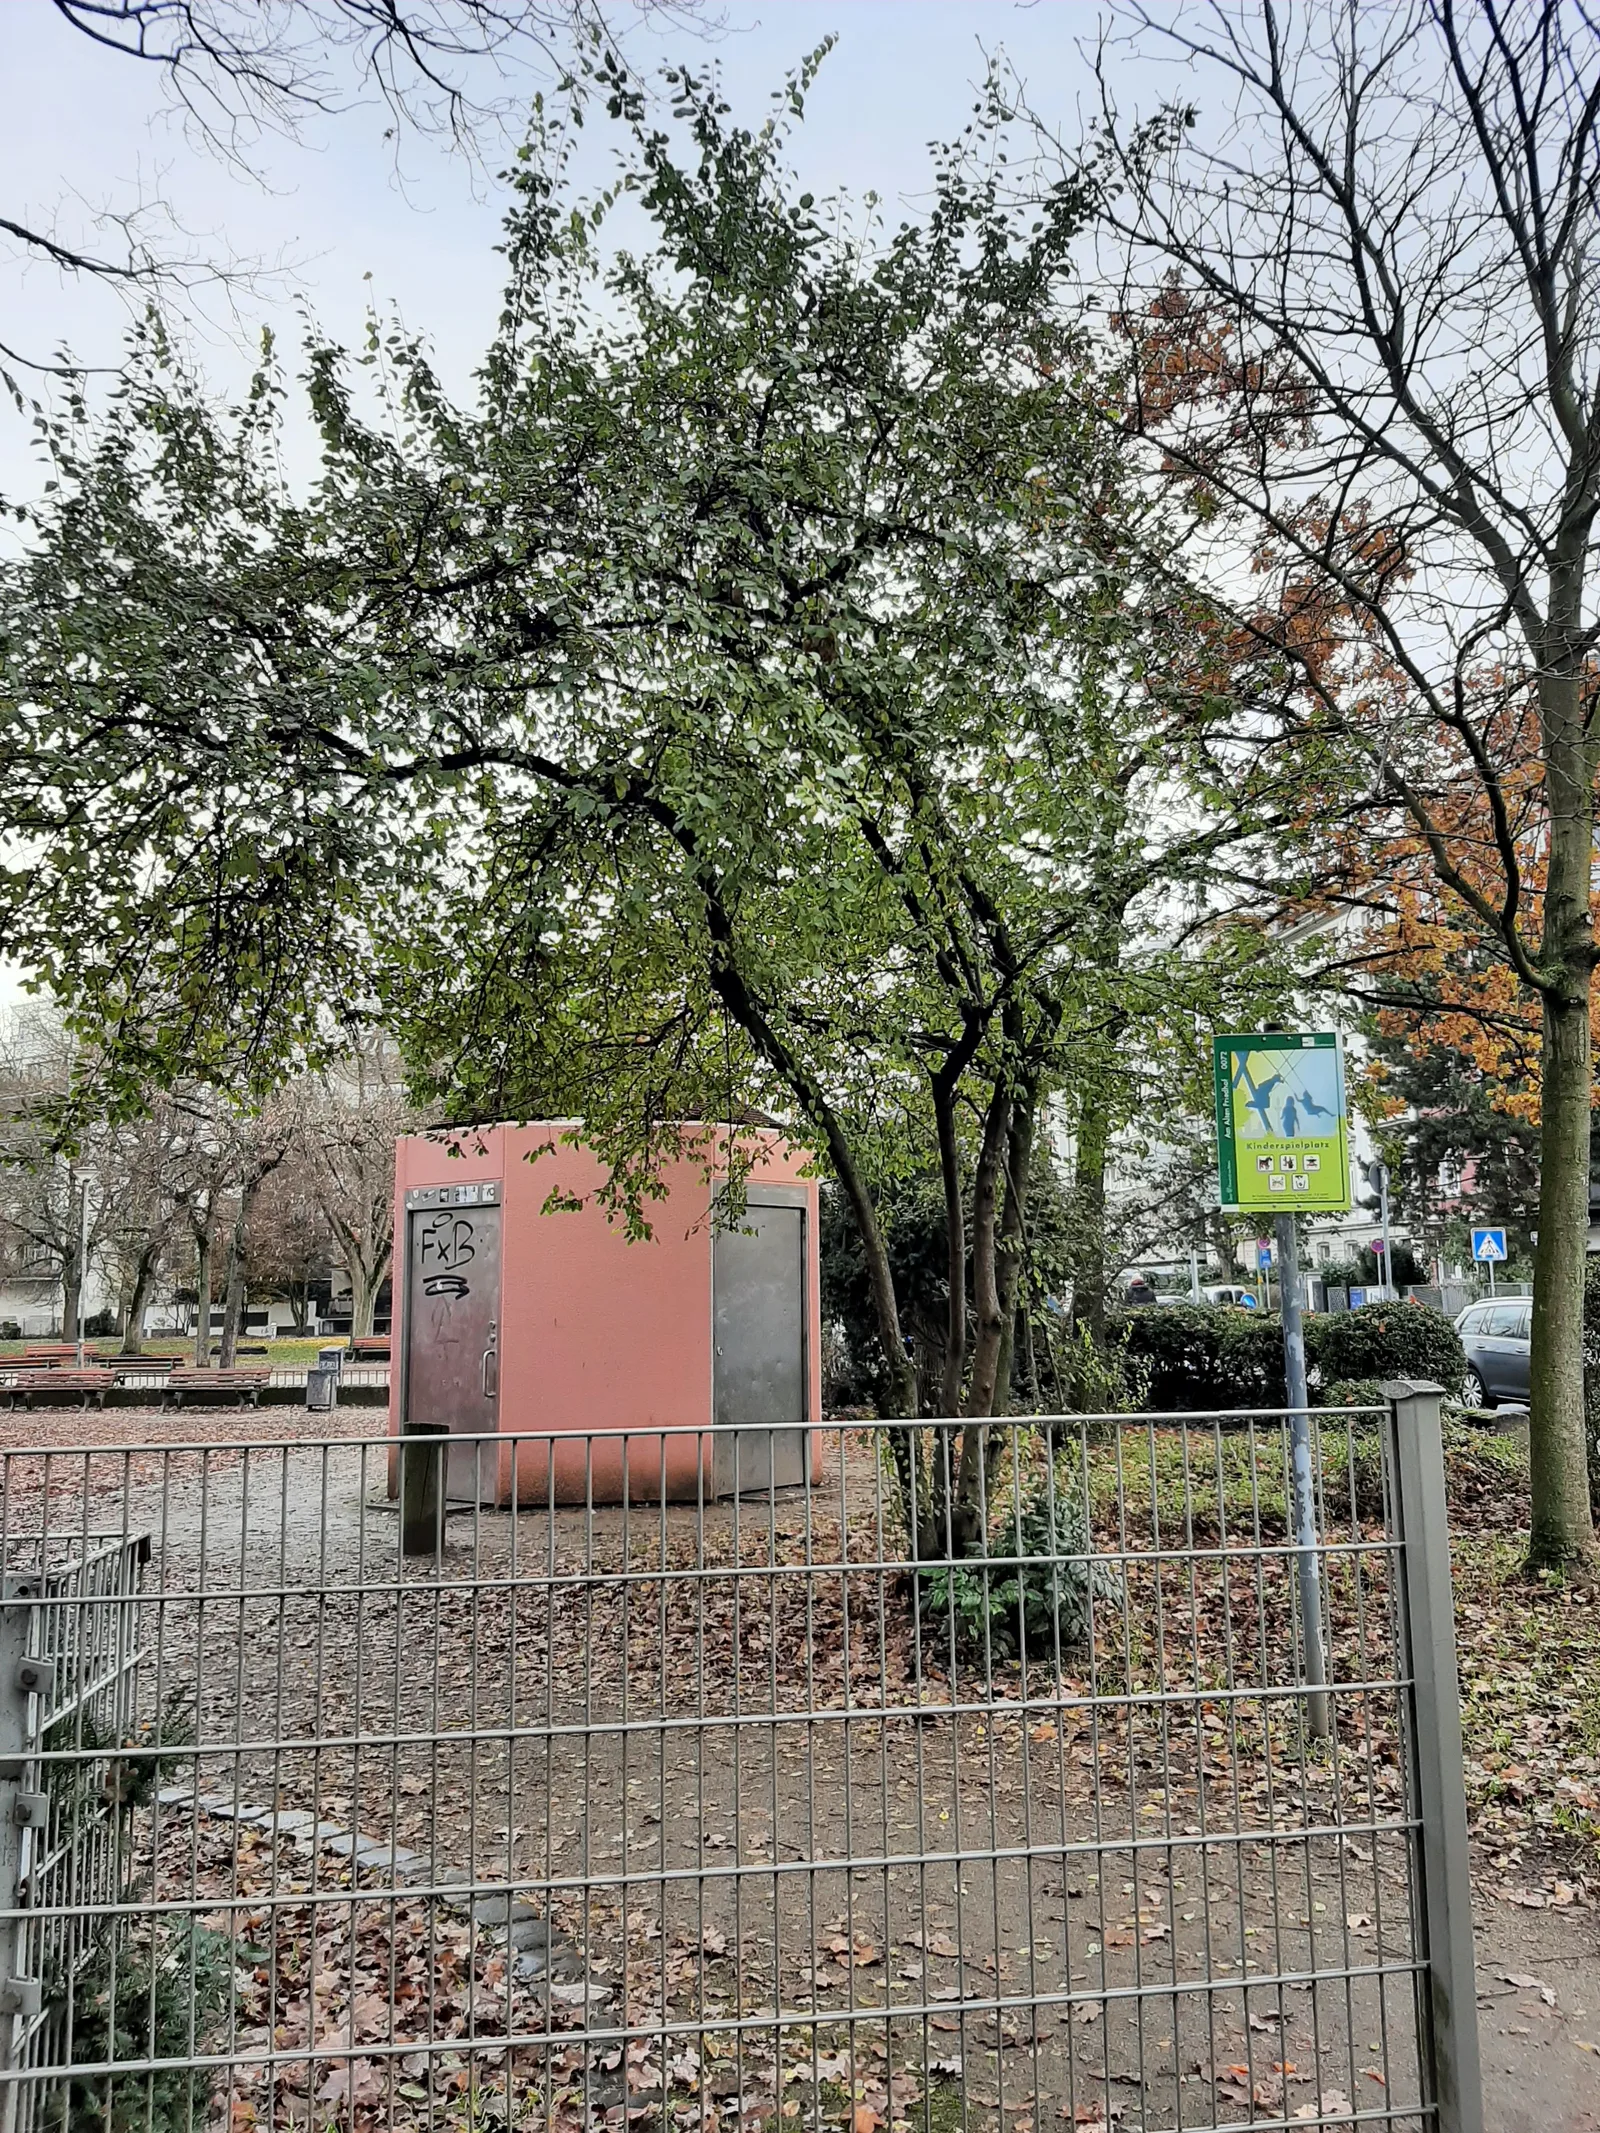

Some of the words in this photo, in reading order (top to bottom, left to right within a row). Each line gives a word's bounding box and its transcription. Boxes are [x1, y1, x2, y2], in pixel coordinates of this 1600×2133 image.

[1220, 1051, 1228, 1070] 0072
[1221, 1079, 1229, 1107] Friedhof
[1224, 1127, 1231, 1138] Am
[1246, 1141, 1329, 1150] Kinderspielplatz
